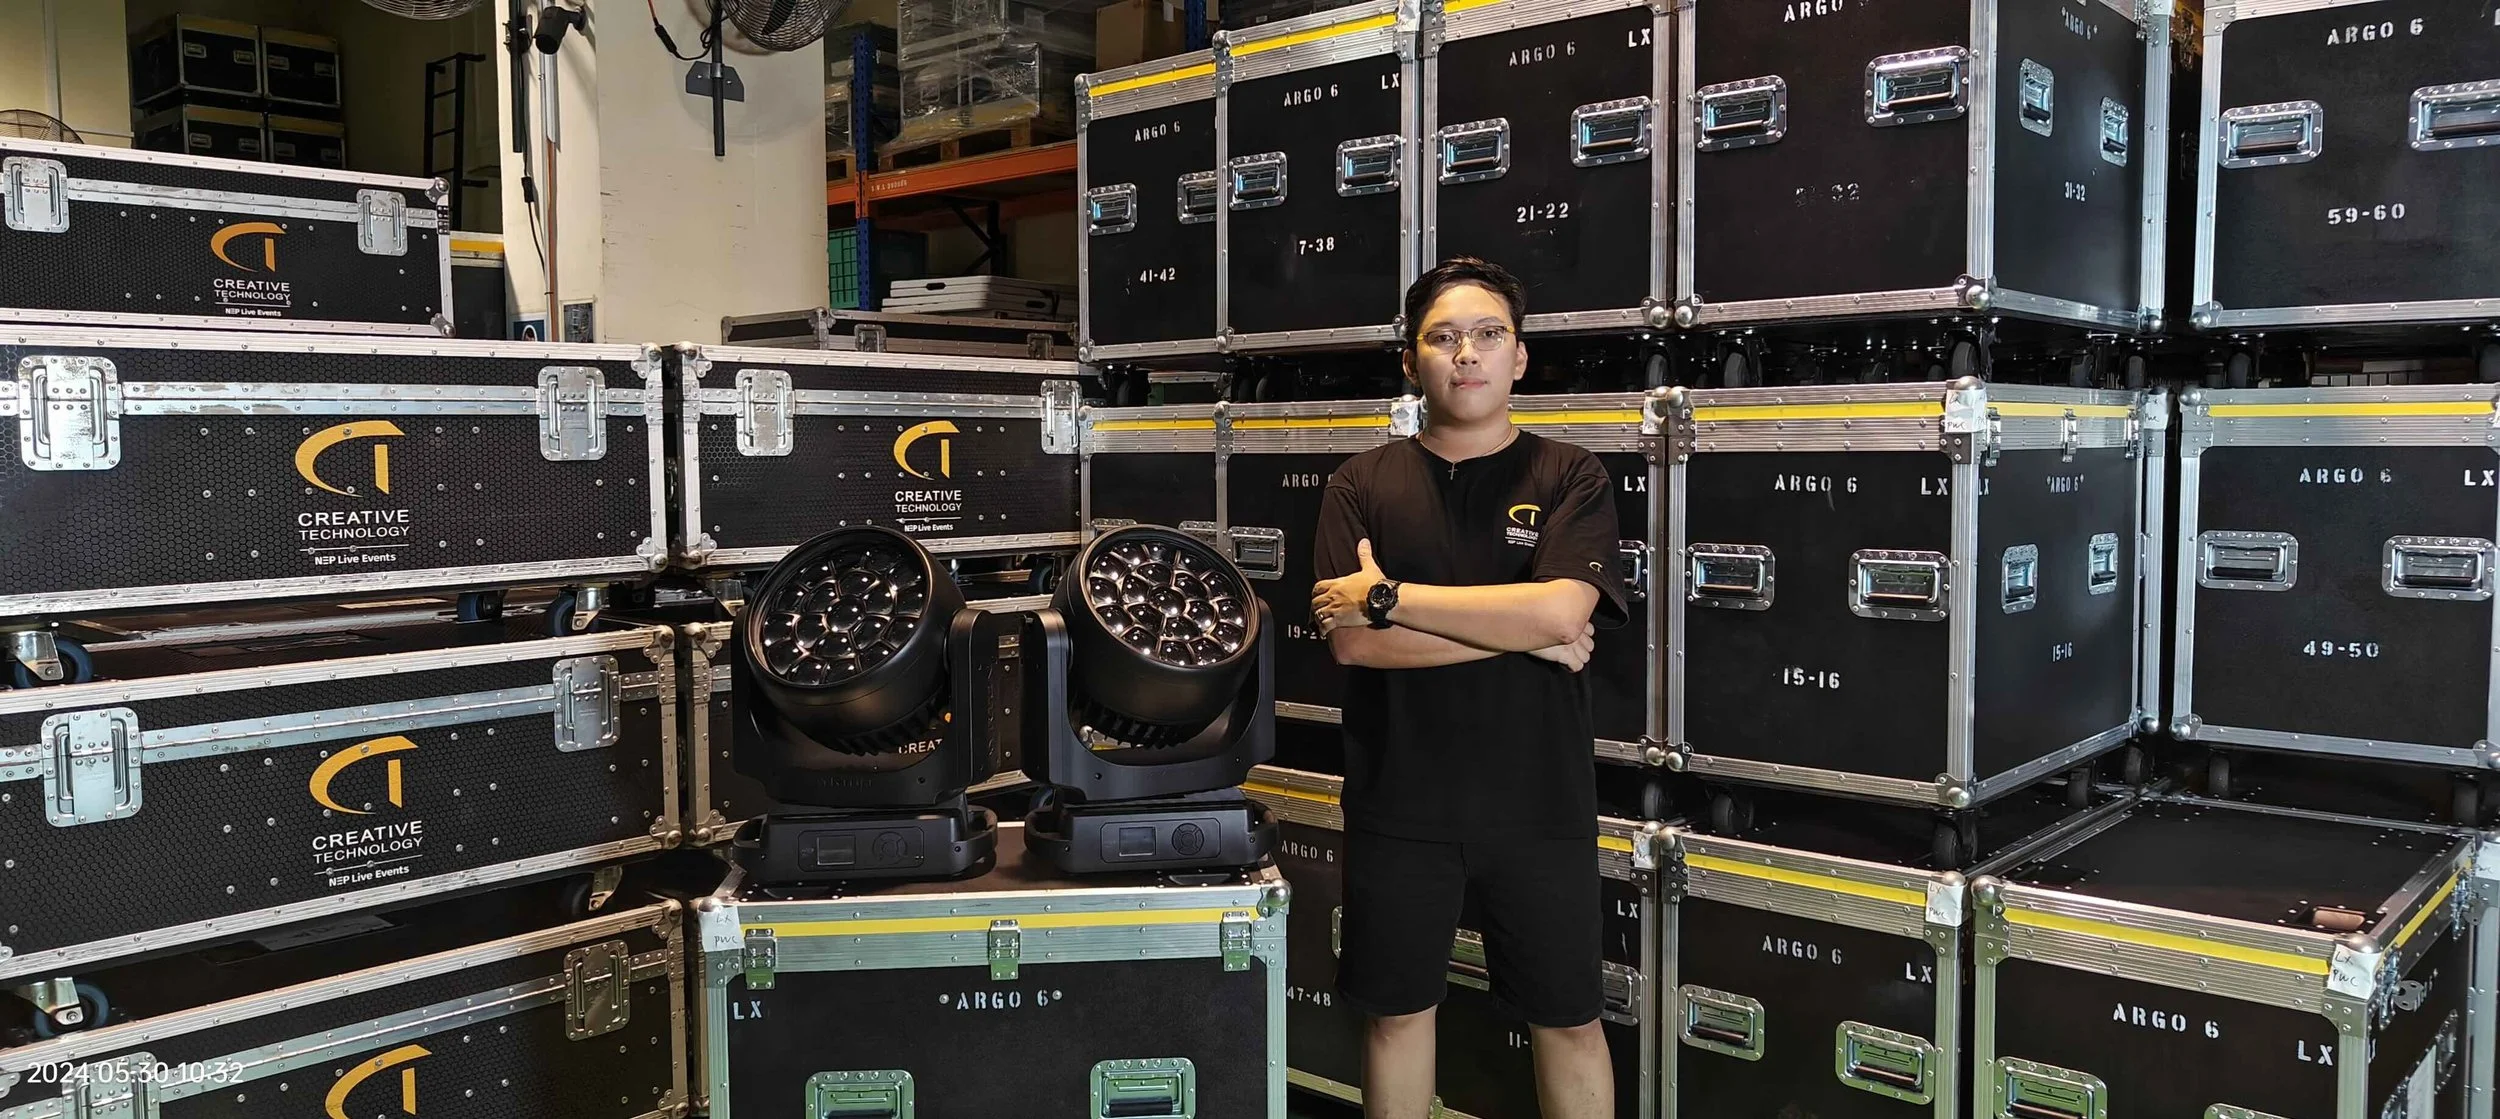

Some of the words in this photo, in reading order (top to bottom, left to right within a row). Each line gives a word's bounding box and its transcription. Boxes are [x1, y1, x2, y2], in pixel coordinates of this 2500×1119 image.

[2064, 11, 2084, 36] ARGO
[2327, 21, 2394, 45] ARGO
[2409, 17, 2424, 35] 6
[1628, 28, 1651, 48] LX
[1509, 44, 1556, 67] ARGO
[1566, 41, 1576, 56] 6
[1381, 72, 1400, 90] LX
[1283, 86, 1322, 107] ARGO
[1330, 83, 1339, 98] 6
[1134, 123, 1167, 142] ARGO
[1173, 121, 1181, 133] 6
[2065, 181, 2086, 202] 31-32
[1516, 202, 1569, 223] 21-22
[2327, 203, 2405, 225] 59-60
[213, 278, 291, 292] CREATIVE
[1139, 267, 1176, 283] 41-42
[213, 289, 291, 301] TECHNOLOGY
[241, 308, 256, 316] Live
[257, 309, 282, 317] Events
[1282, 473, 1319, 488] ARGO
[1624, 475, 1646, 492] LX
[1774, 473, 1832, 492] ARGO
[1847, 476, 1857, 493] 6
[2050, 476, 2071, 493] ARGO
[2074, 476, 2079, 492] 6
[2299, 467, 2364, 484] ARGO
[2380, 468, 2392, 484] 6
[2464, 469, 2495, 487] LX
[894, 490, 962, 502] CREATIVE
[1921, 477, 1948, 496] LX
[298, 509, 410, 527] CREATIVE
[895, 503, 962, 513] TECHNOLOGY
[298, 526, 410, 541] TECHNOLOGY
[932, 523, 954, 531] Events
[1506, 526, 1539, 537] CREATIVE
[1506, 532, 1538, 540] TECHNOLOGY
[338, 555, 360, 564] Live
[362, 553, 396, 562] Events
[1287, 624, 1327, 640] 19-2
[2052, 641, 2073, 662] 15-16
[2303, 640, 2379, 658] 49-50
[1783, 667, 1840, 689] 15-16
[312, 820, 423, 851] CREATIVE
[313, 837, 424, 864] TECHNOLOGY
[1281, 839, 1318, 859] ARGO
[1326, 849, 1334, 863] 6
[352, 872, 373, 883] Live
[375, 866, 410, 878] Events
[1617, 899, 1638, 919] LX
[1762, 935, 1818, 960] ARGO
[1831, 948, 1842, 965] 6
[1905, 962, 1932, 984] LX
[956, 991, 1021, 1010] ARGO
[1037, 989, 1049, 1007] 6
[1286, 984, 1331, 1008] 47-48
[732, 1000, 762, 1020] LX
[2113, 1002, 2186, 1032] ARGO
[2204, 1020, 2219, 1039] 6
[2297, 1039, 2333, 1066] LX
